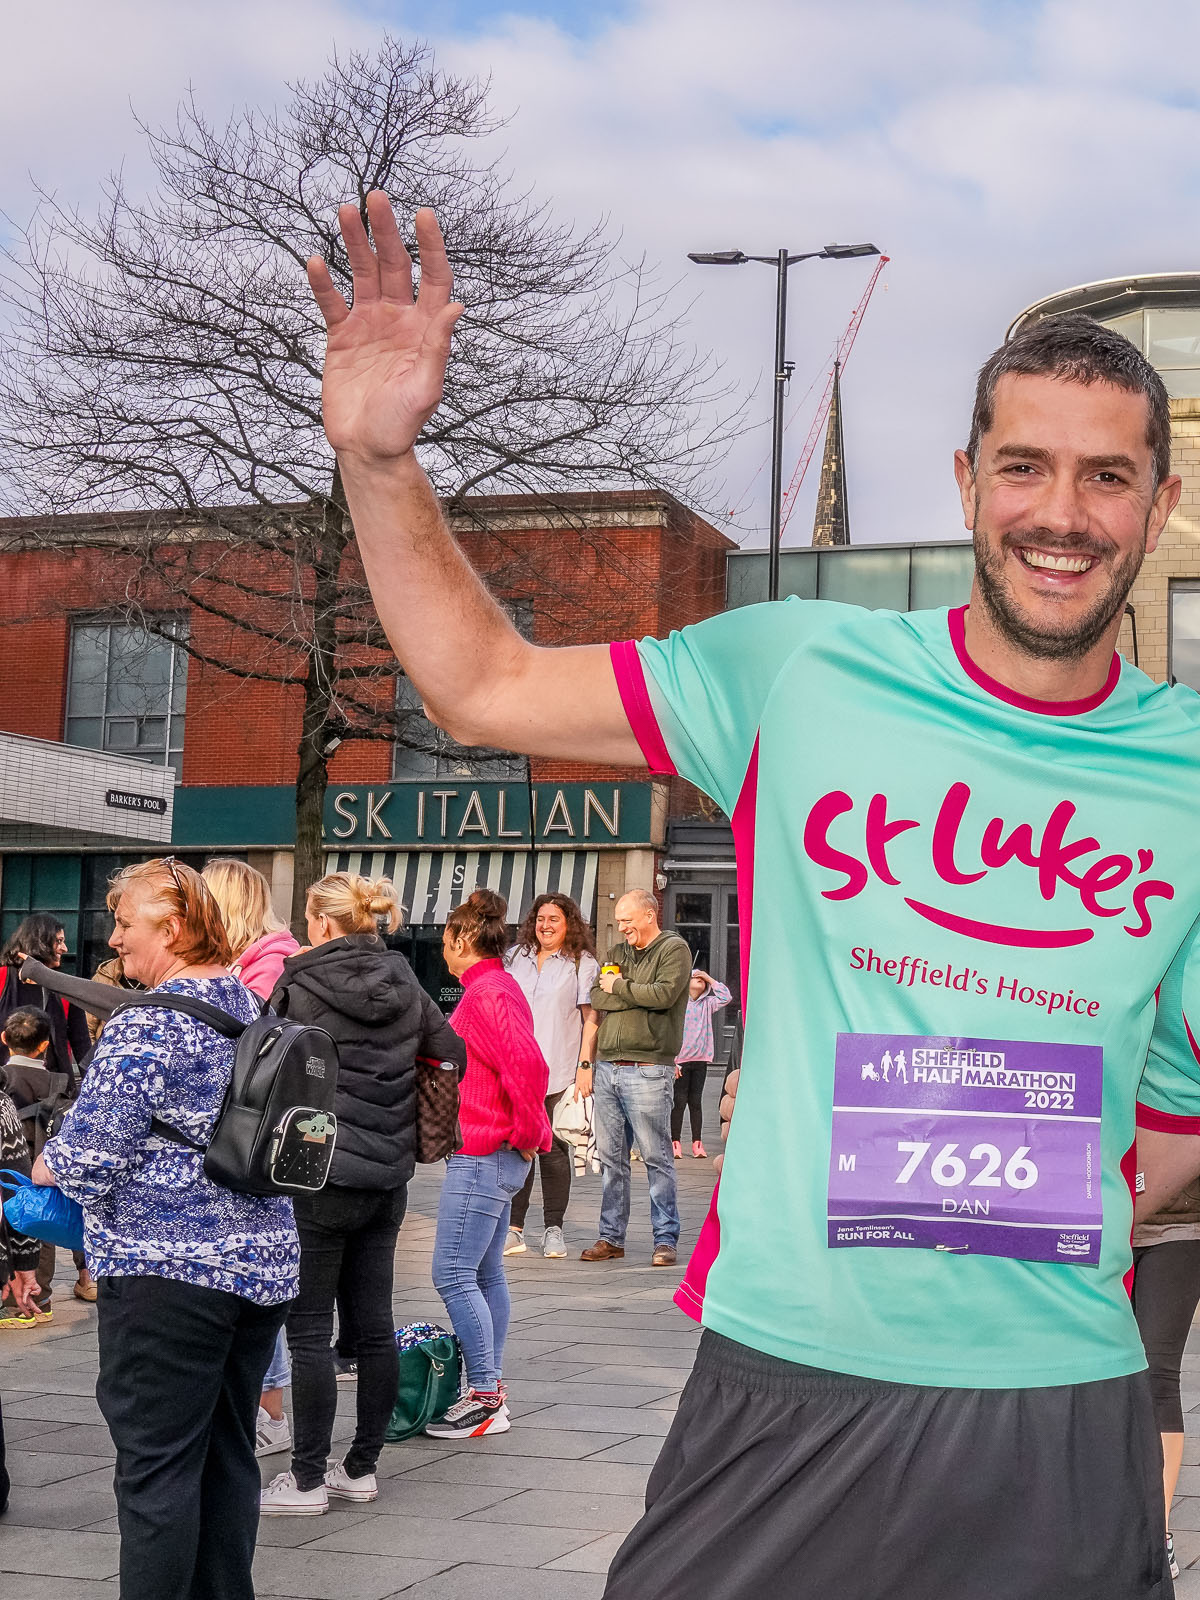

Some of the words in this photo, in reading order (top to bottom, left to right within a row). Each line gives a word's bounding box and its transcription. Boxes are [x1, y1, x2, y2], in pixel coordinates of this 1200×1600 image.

[110, 793, 141, 807] BARKER'S
[143, 799, 161, 810] POOL
[321, 790, 393, 838] SK
[417, 789, 620, 838] ITALIAN
[803, 790, 921, 901] St
[850, 946, 989, 995] Sheffield's
[996, 976, 1101, 1018] Hospice
[914, 1049, 1003, 1068] SHEFFIELD
[913, 1067, 961, 1085] HALF
[964, 1069, 1073, 1090] MARATHON
[1024, 1091, 1075, 1110] 2022
[838, 1154, 857, 1172] M
[895, 1141, 1039, 1190] 7626
[941, 1198, 990, 1216] DAN
[837, 1232, 863, 1241] RUN
[866, 1230, 890, 1240] FOR
[893, 1230, 915, 1241] ALL
[855, 1224, 895, 1232] Tomlinson's
[1060, 1233, 1090, 1241] Sheffield
[457, 1411, 488, 1428] NAUTICA
